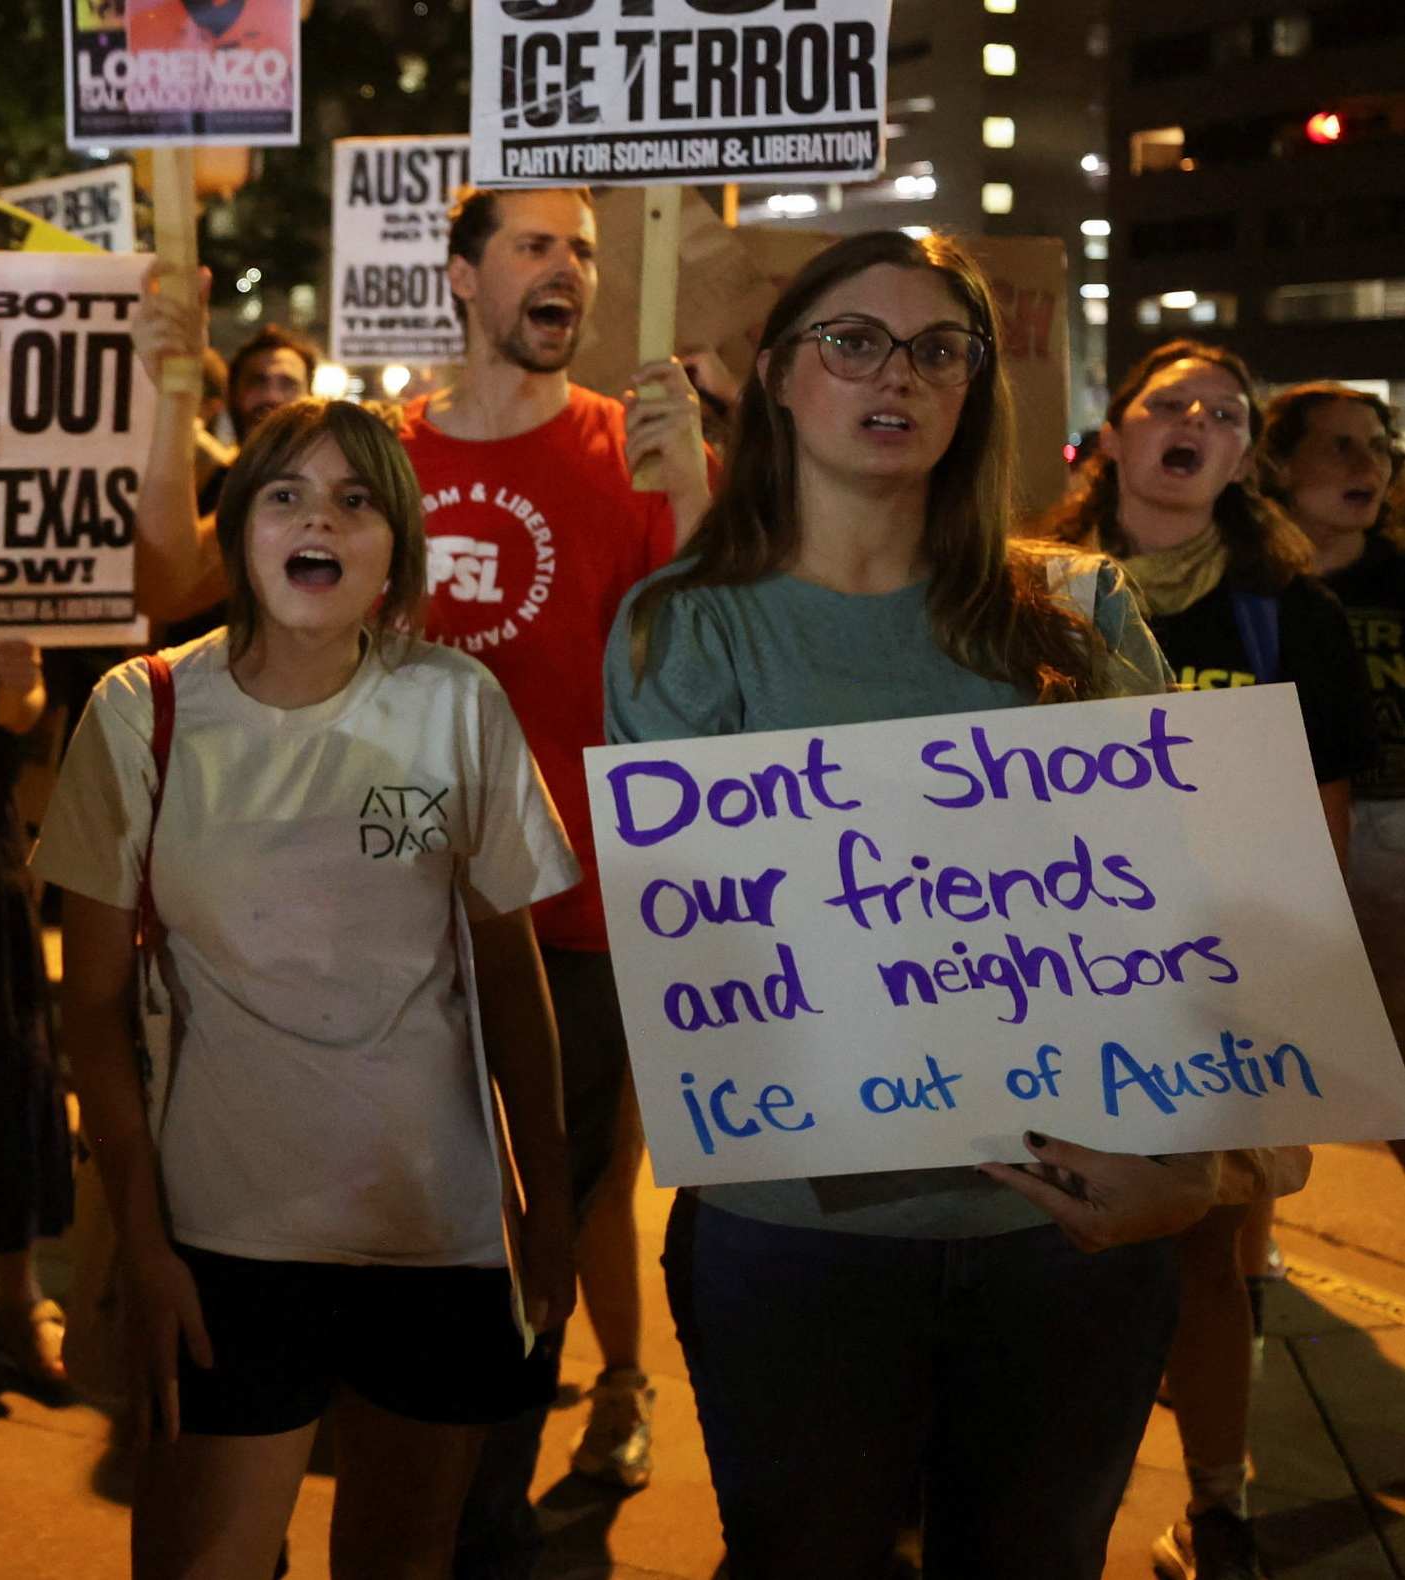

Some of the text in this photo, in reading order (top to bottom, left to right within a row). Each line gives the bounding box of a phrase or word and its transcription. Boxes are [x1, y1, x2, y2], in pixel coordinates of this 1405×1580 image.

[78, 50, 289, 86] LORENZO
[502, 21, 877, 128] ICE TERROR
[348, 148, 470, 207] AUSTI
[506, 131, 873, 176] PARTY FOR SOCIALISM & LIBERATION
[342, 264, 448, 309] ABBOT
[343, 316, 452, 331] THREA
[10, 330, 134, 434] OUT
[426, 552, 504, 603] PSL
[469, 481, 487, 503] &
[494, 484, 557, 622] LIBERATION
[359, 785, 450, 822] ATX
[606, 707, 1198, 847] Dont shoot
[640, 829, 1157, 939] our friends
[663, 932, 1239, 1032] and neighbors
[679, 1030, 1324, 1155] ice out of Austin
